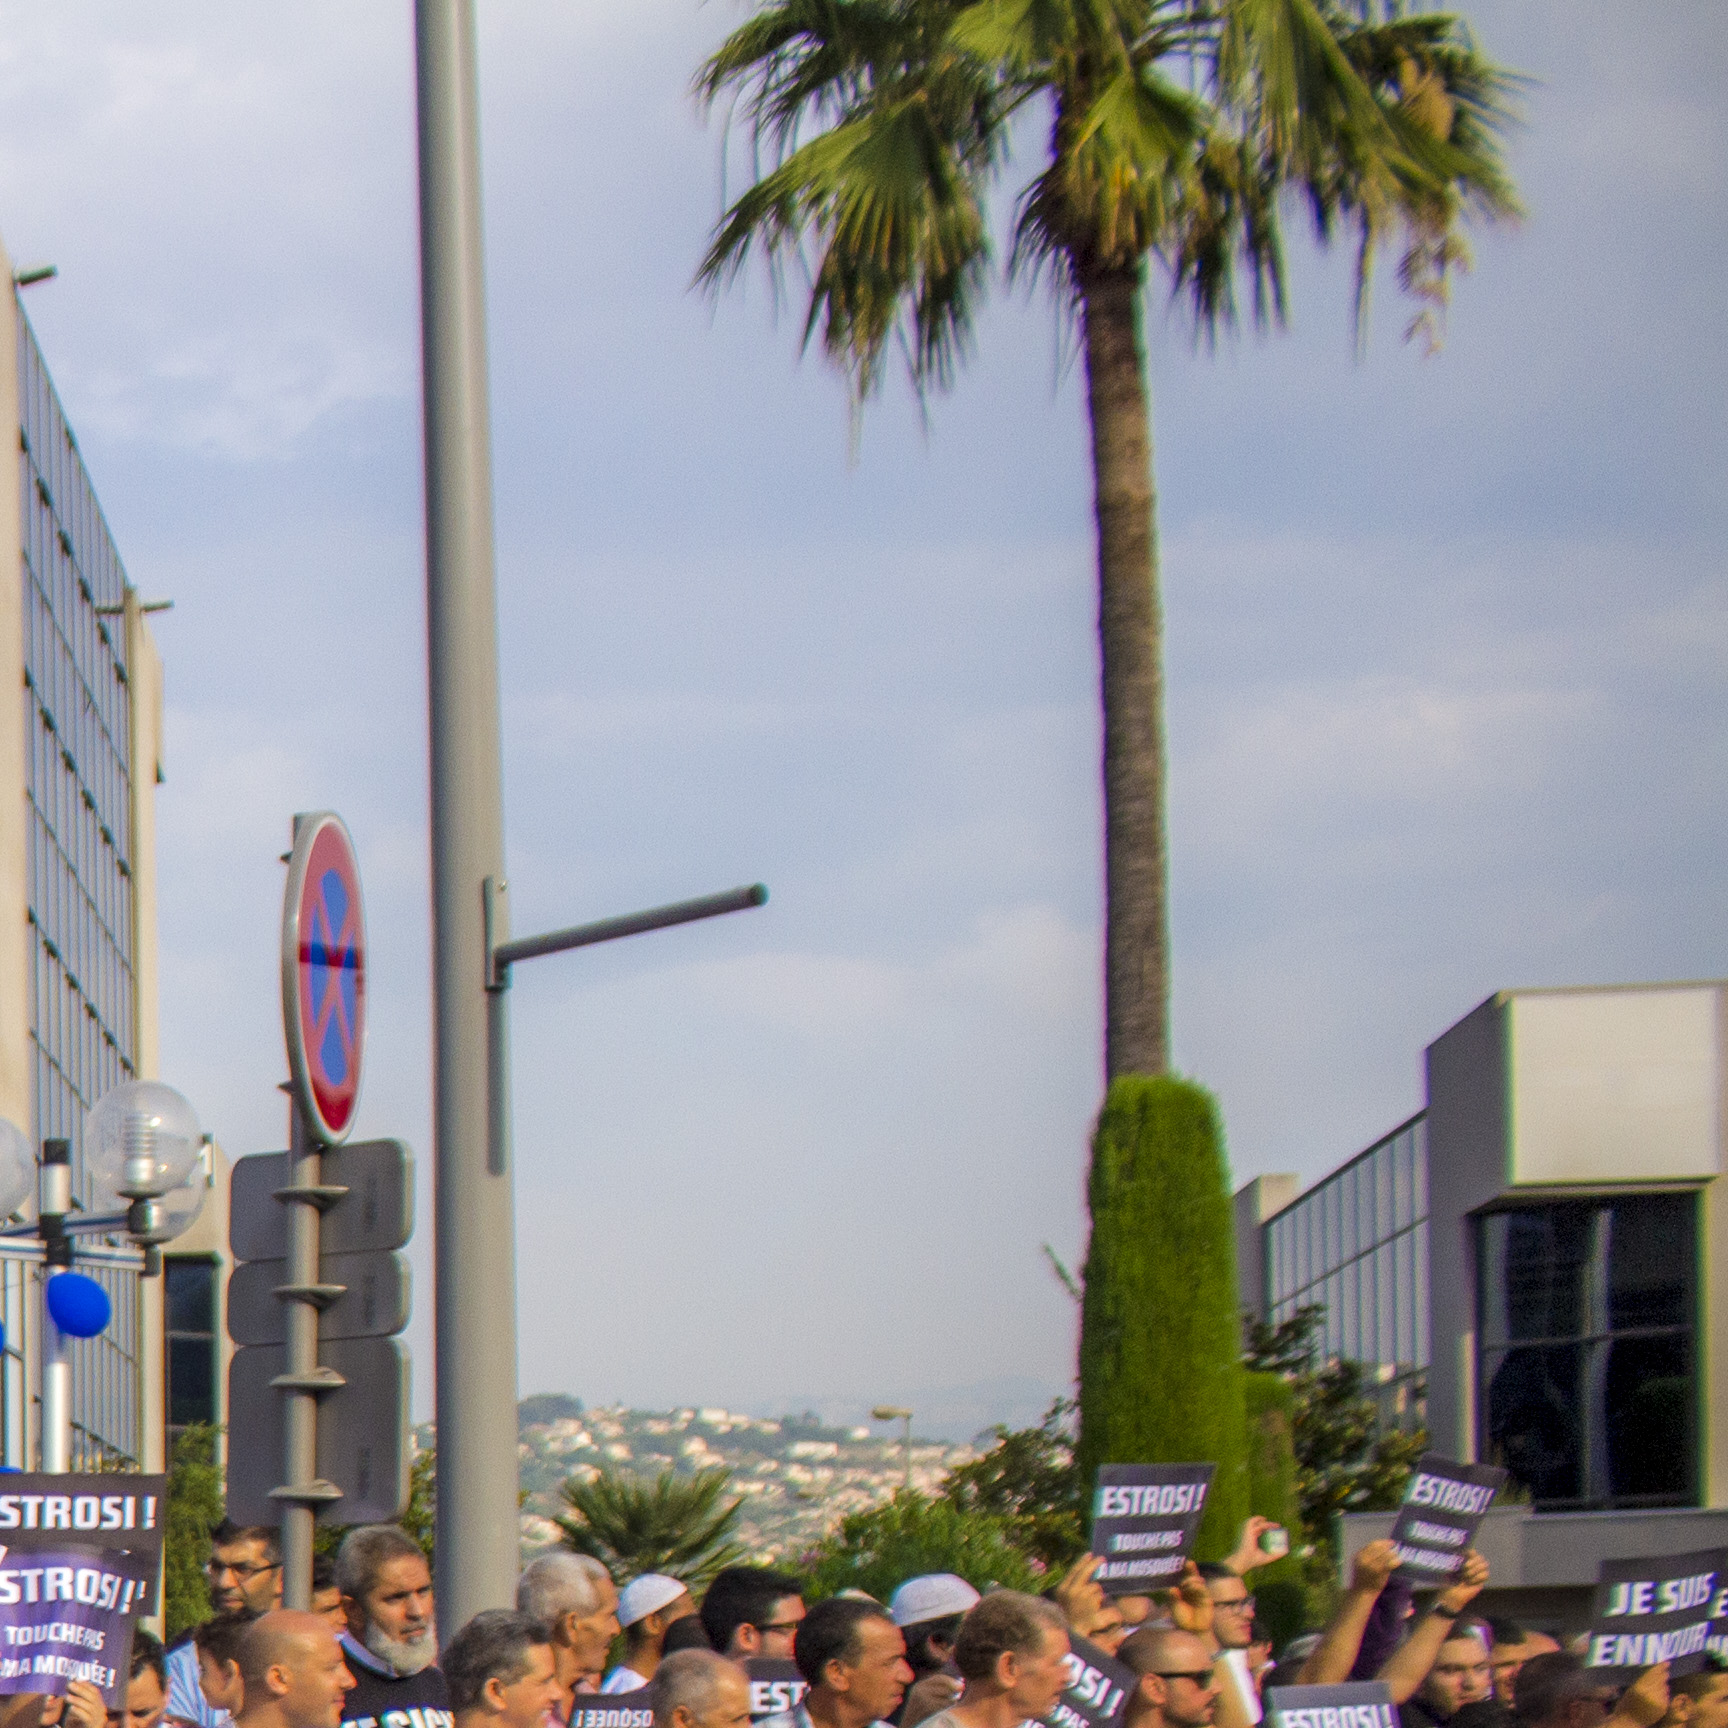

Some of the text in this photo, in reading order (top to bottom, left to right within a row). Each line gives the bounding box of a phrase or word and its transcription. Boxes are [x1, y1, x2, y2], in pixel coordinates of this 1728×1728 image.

[1603, 1581, 1656, 1618] JE
[1655, 1572, 1718, 1614] SUIS
[1586, 1621, 1713, 1669] ENNOUR
